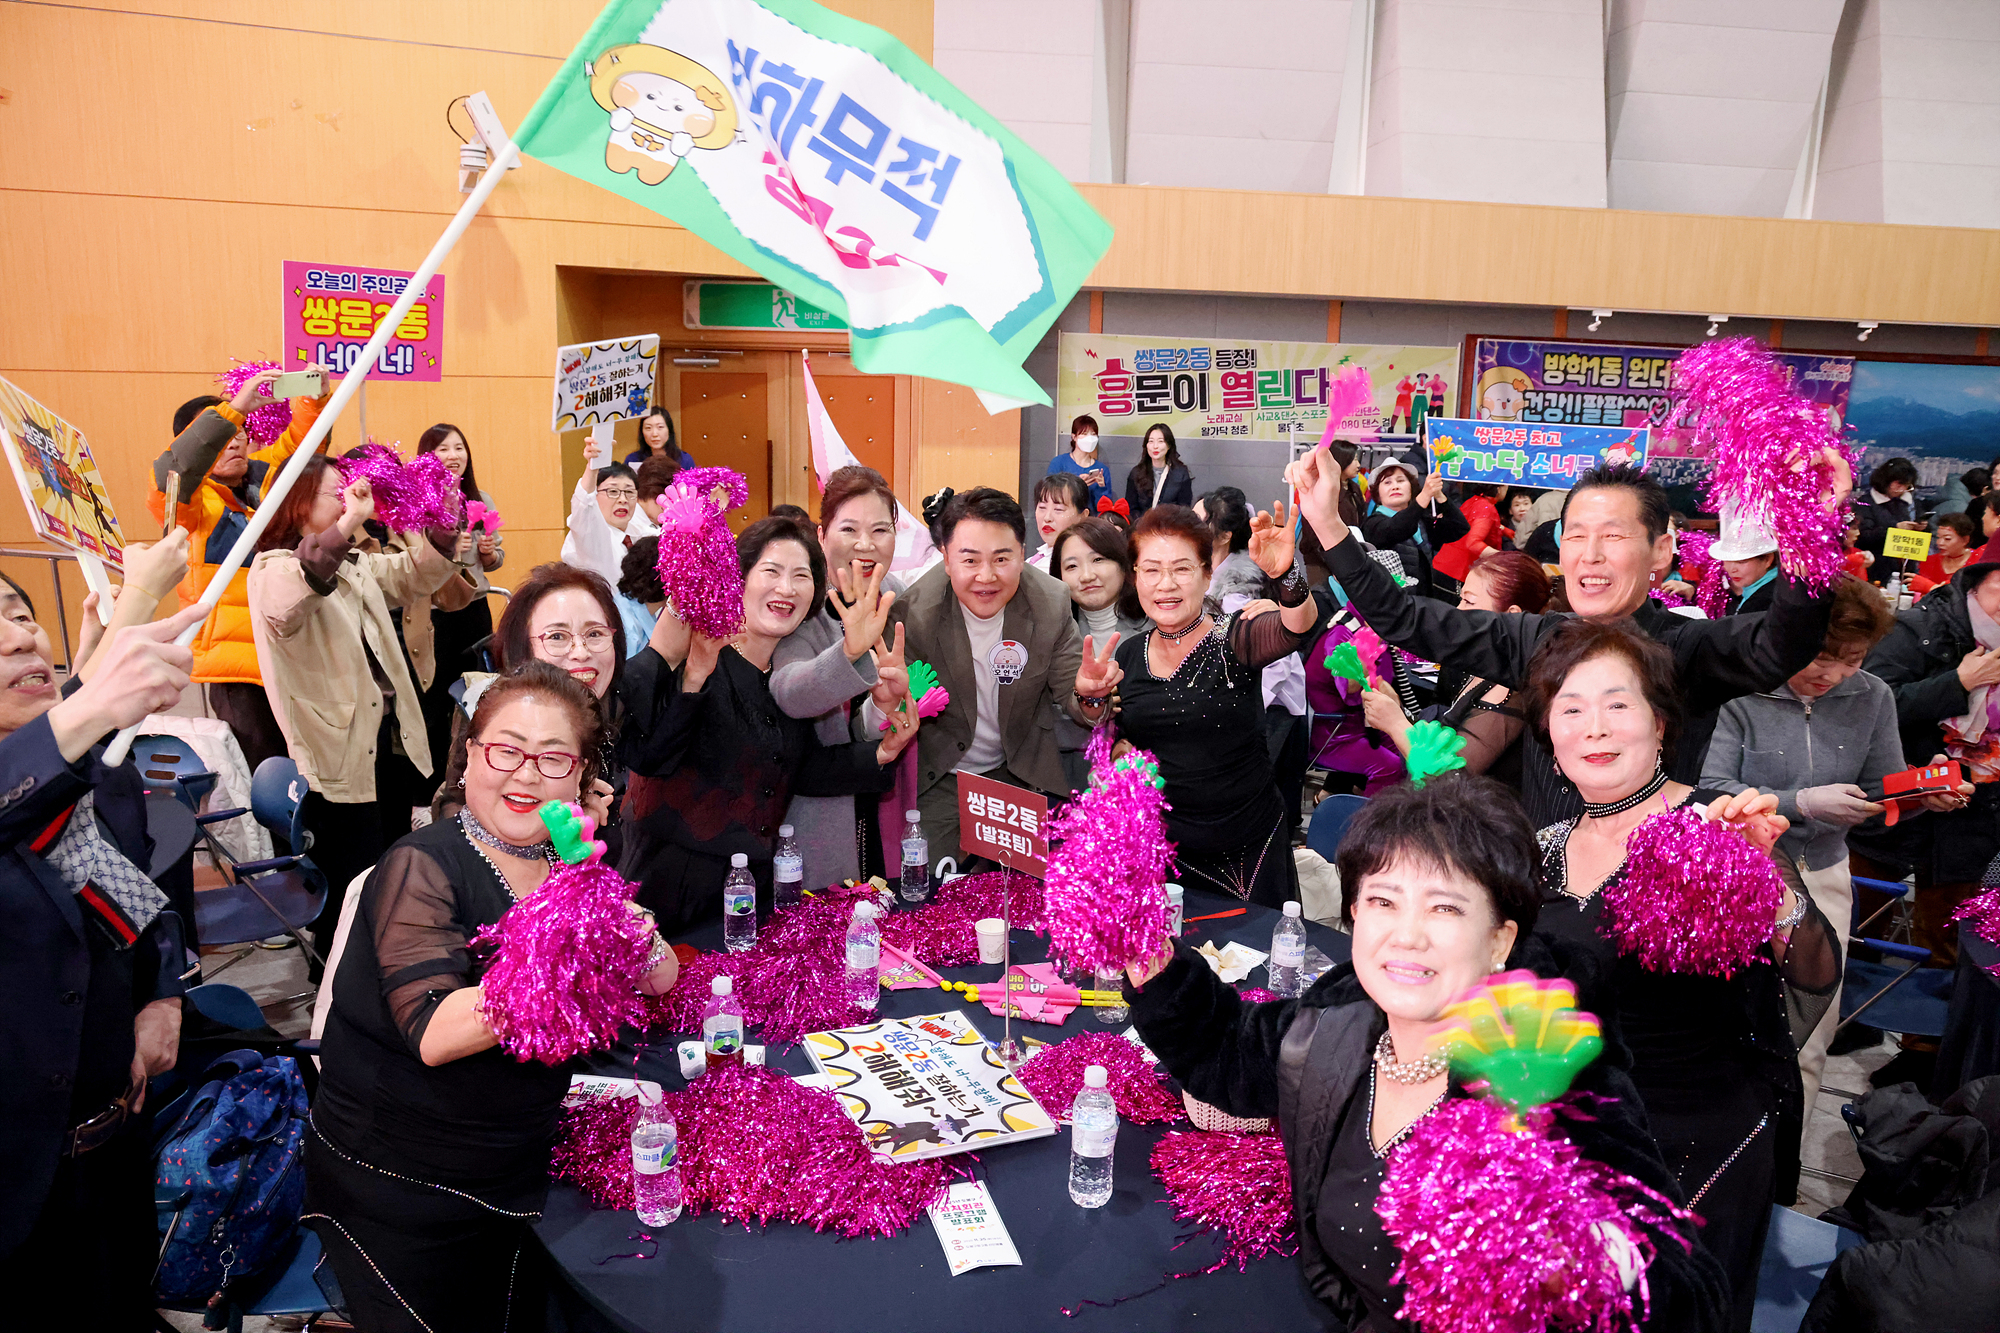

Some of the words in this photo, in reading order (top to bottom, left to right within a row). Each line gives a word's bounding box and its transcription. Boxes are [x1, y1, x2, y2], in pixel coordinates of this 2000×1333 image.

[727, 39, 961, 242] 하무적
[306, 270, 357, 292] 오늘의
[361, 274, 426, 298] 주인공
[378, 344, 414, 375] 너!
[1134, 347, 1211, 373] 쌍문2동
[1215, 348, 1257, 369] 등장!
[1543, 353, 1622, 387] 방학1동
[569, 373, 607, 393] 쌍문2동
[609, 363, 643, 381] 잘하는거
[1092, 358, 1210, 416] 흥문이
[1207, 412, 1243, 424] 노래교실
[1256, 411, 1298, 421] 사교&댄스
[1301, 410, 1328, 419] 스포츠
[1346, 406, 1380, 417] 인댄스
[1231, 425, 1249, 435] 청춘
[1336, 419, 1359, 429] 080
[1362, 418, 1379, 428] 댄스
[1474, 426, 1528, 446] 쌍문2동
[1530, 428, 1562, 446] 최고
[966, 791, 1039, 834] 쌍문2동
[975, 821, 1033, 857] (발표팀)
[919, 1021, 955, 1039] WOW
[930, 1046, 957, 1068] 잘해도
[883, 1030, 940, 1073] 쌍문2동
[926, 1072, 984, 1118] 잘하는거
[939, 1202, 984, 1213] 자치회관
[942, 1209, 987, 1220] 프로그램
[950, 1216, 985, 1225] 발표회
